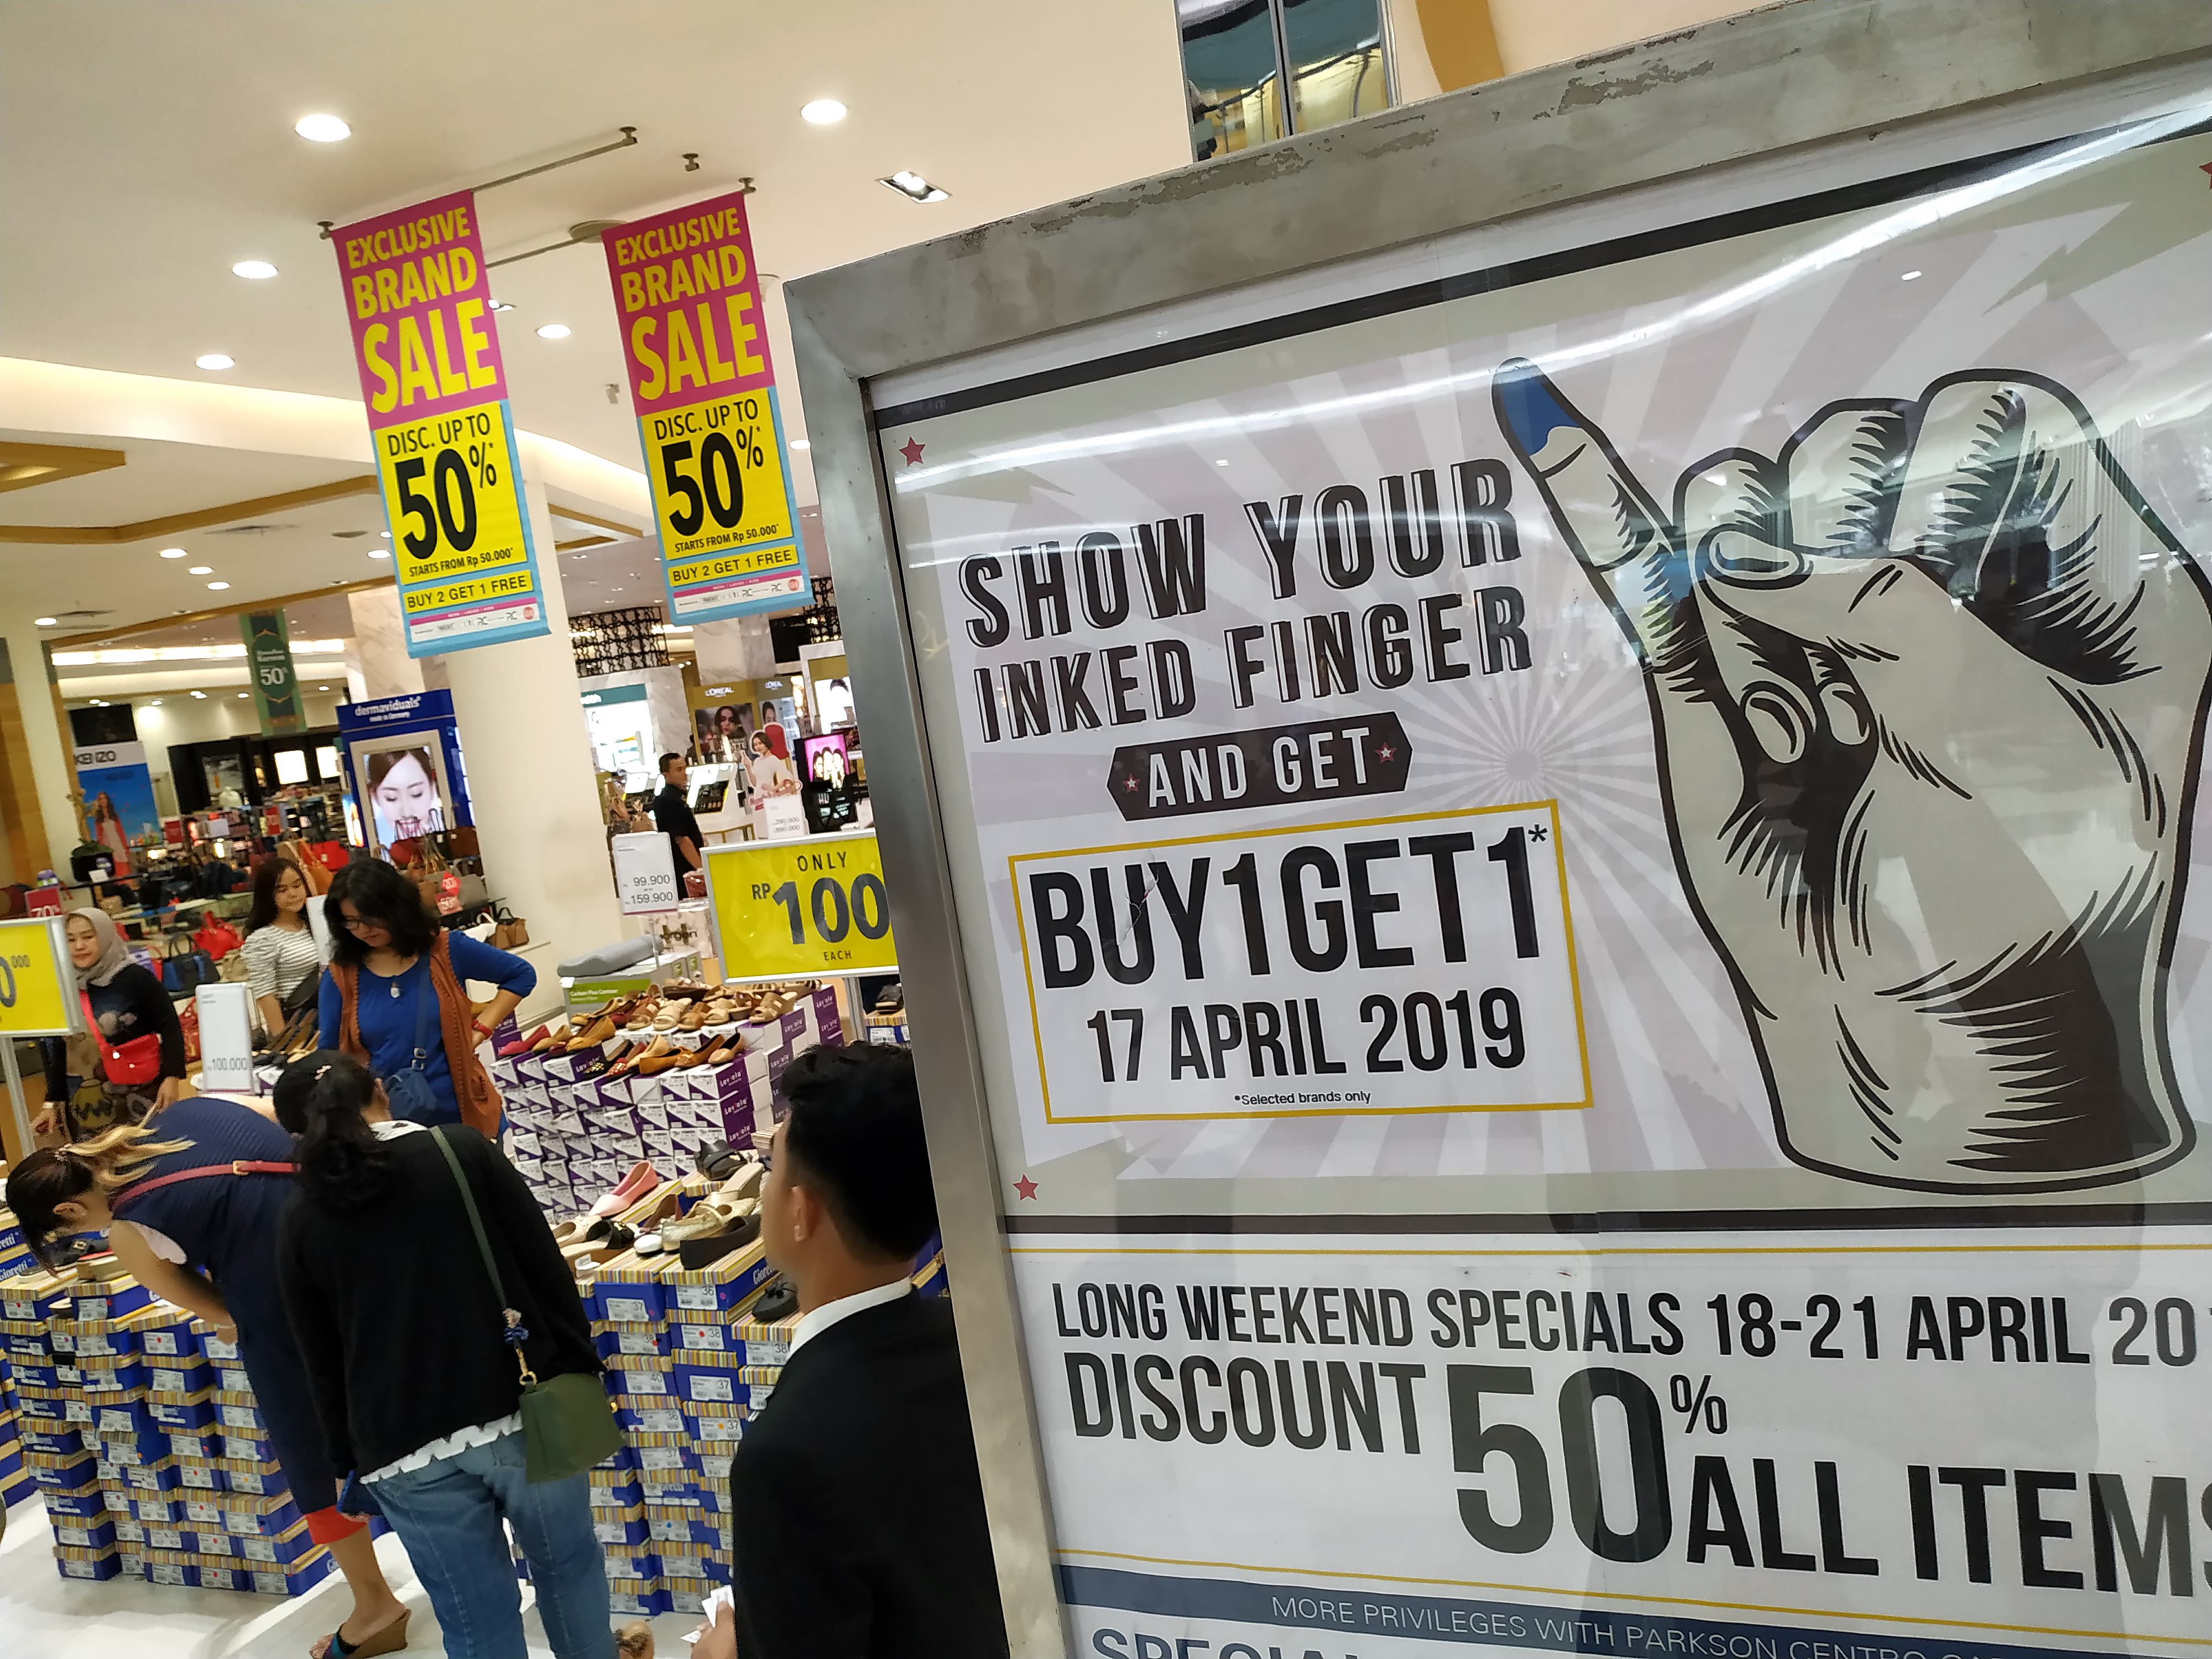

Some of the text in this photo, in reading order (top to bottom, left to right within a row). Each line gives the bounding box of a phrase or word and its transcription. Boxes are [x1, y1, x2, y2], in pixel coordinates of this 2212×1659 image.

[345, 207, 471, 269] EXCLUSIVE
[615, 207, 741, 266] EXCLUSIVE
[351, 246, 477, 320] BRAND
[619, 244, 747, 312] BRAND
[363, 297, 497, 414] SALE
[630, 291, 764, 400] SALE
[387, 412, 491, 457] DISC. UP TO
[654, 398, 758, 440] DISC. UP TO
[409, 562, 439, 577] STARTS
[440, 557, 465, 569] FROM
[466, 556, 478, 568] Rp
[672, 550, 792, 582] BUY 2 GET 1 FREE
[675, 539, 705, 552] STARTS
[706, 534, 731, 546] FROM
[733, 532, 744, 543] Rp
[957, 458, 1522, 648] SHOW YOUR
[407, 575, 527, 608] BUY 2 GET 1 FREE
[973, 586, 1533, 743] INKED FINGER
[1146, 726, 1371, 808] AND GET
[633, 874, 670, 886] 99.900
[797, 851, 847, 872] ONLY
[631, 891, 673, 904] 159.900
[751, 872, 890, 945] RP 100
[824, 950, 852, 961] EACH
[1086, 986, 1525, 1083] 17 APRIL 2019
[1299, 1091, 1341, 1103] brands
[1345, 1091, 1371, 1104] only
[702, 1286, 714, 1296] 36
[708, 1328, 721, 1338] 38
[775, 1344, 787, 1354] 38
[1052, 1282, 2212, 1367] LONG WEEKEND SPECIALS 18-21 APRIL 20
[718, 1380, 729, 1390] 37
[1063, 1352, 1426, 1455] DISCOUNT
[1686, 1455, 2212, 1598] ALL ITEM
[1272, 1597, 1355, 1625] MORE
[1364, 1605, 1526, 1638] PRIVILEGES
[1534, 1618, 1614, 1647] WITH
[1625, 1626, 1777, 1659] PARKSON
